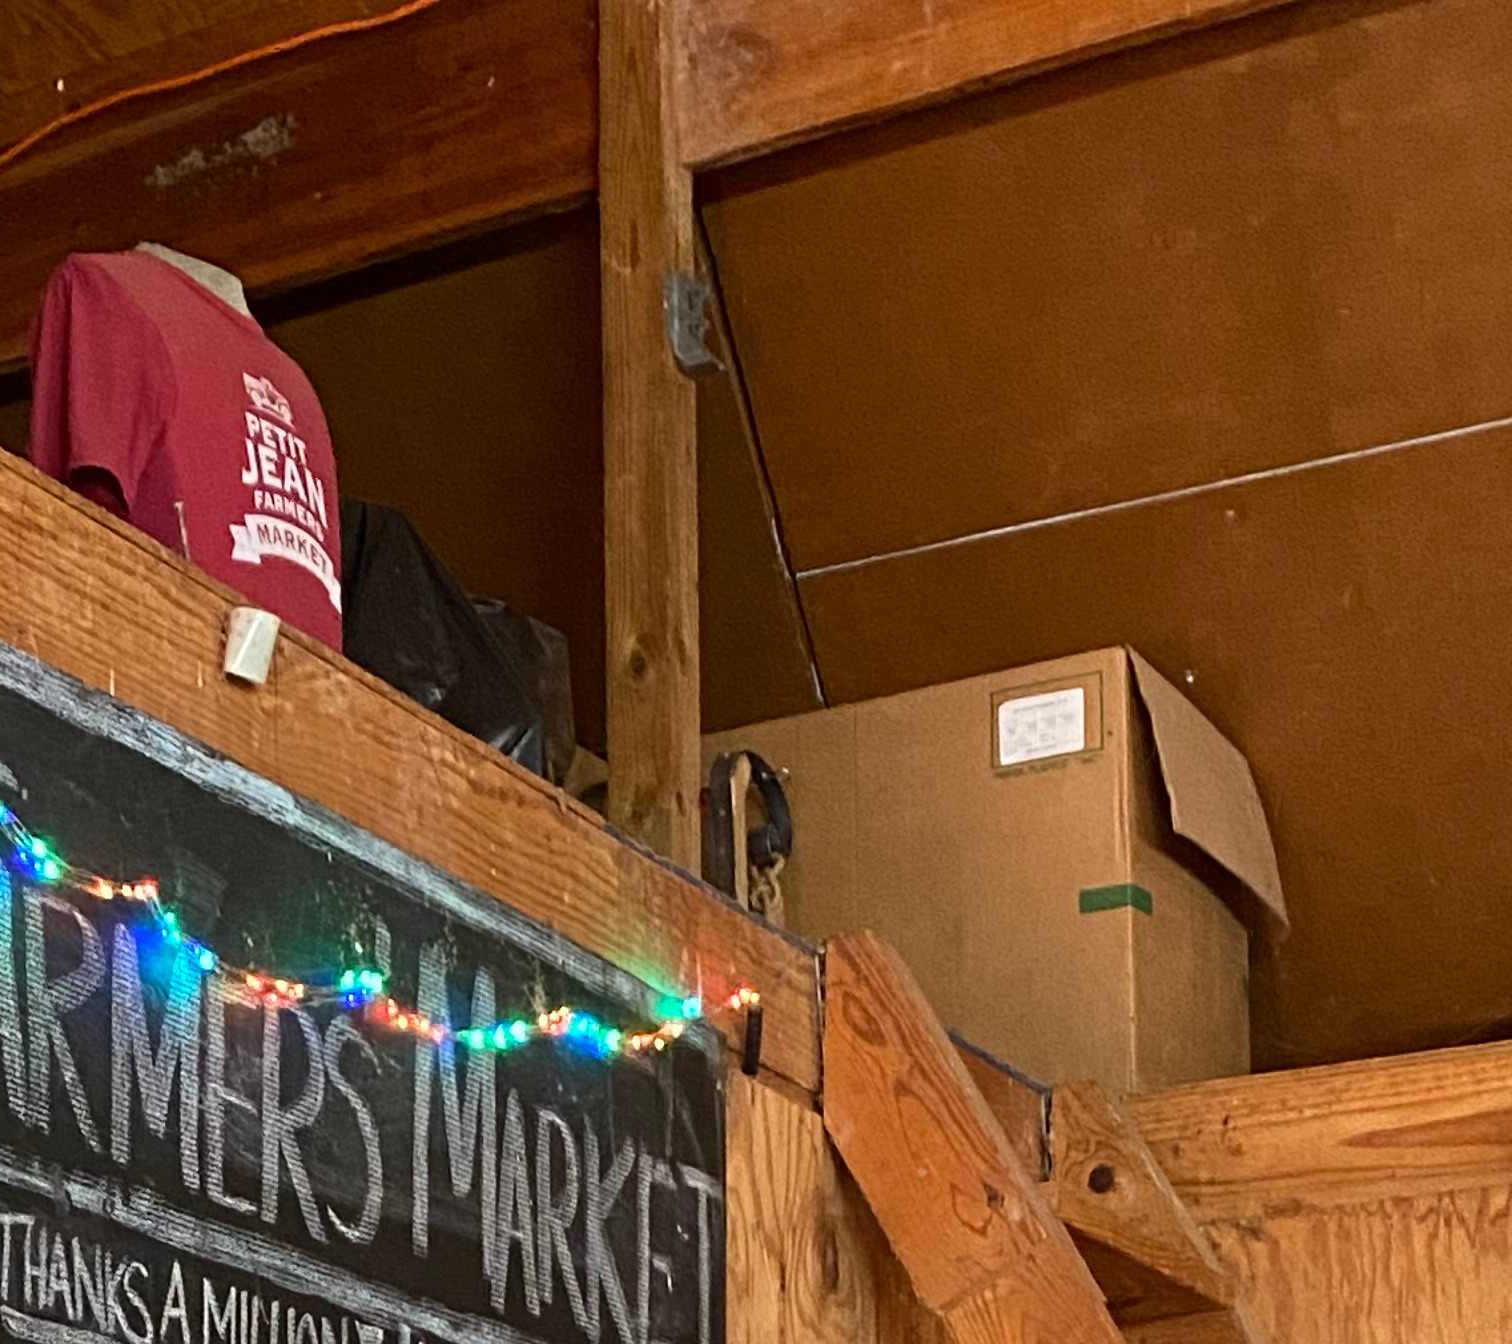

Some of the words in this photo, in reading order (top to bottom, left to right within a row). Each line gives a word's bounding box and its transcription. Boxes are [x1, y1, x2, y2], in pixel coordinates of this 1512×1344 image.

[245, 411, 307, 465] PETIT
[242, 438, 327, 529] JEAN
[254, 490, 324, 542] FARMERS
[257, 523, 328, 574] MARKET
